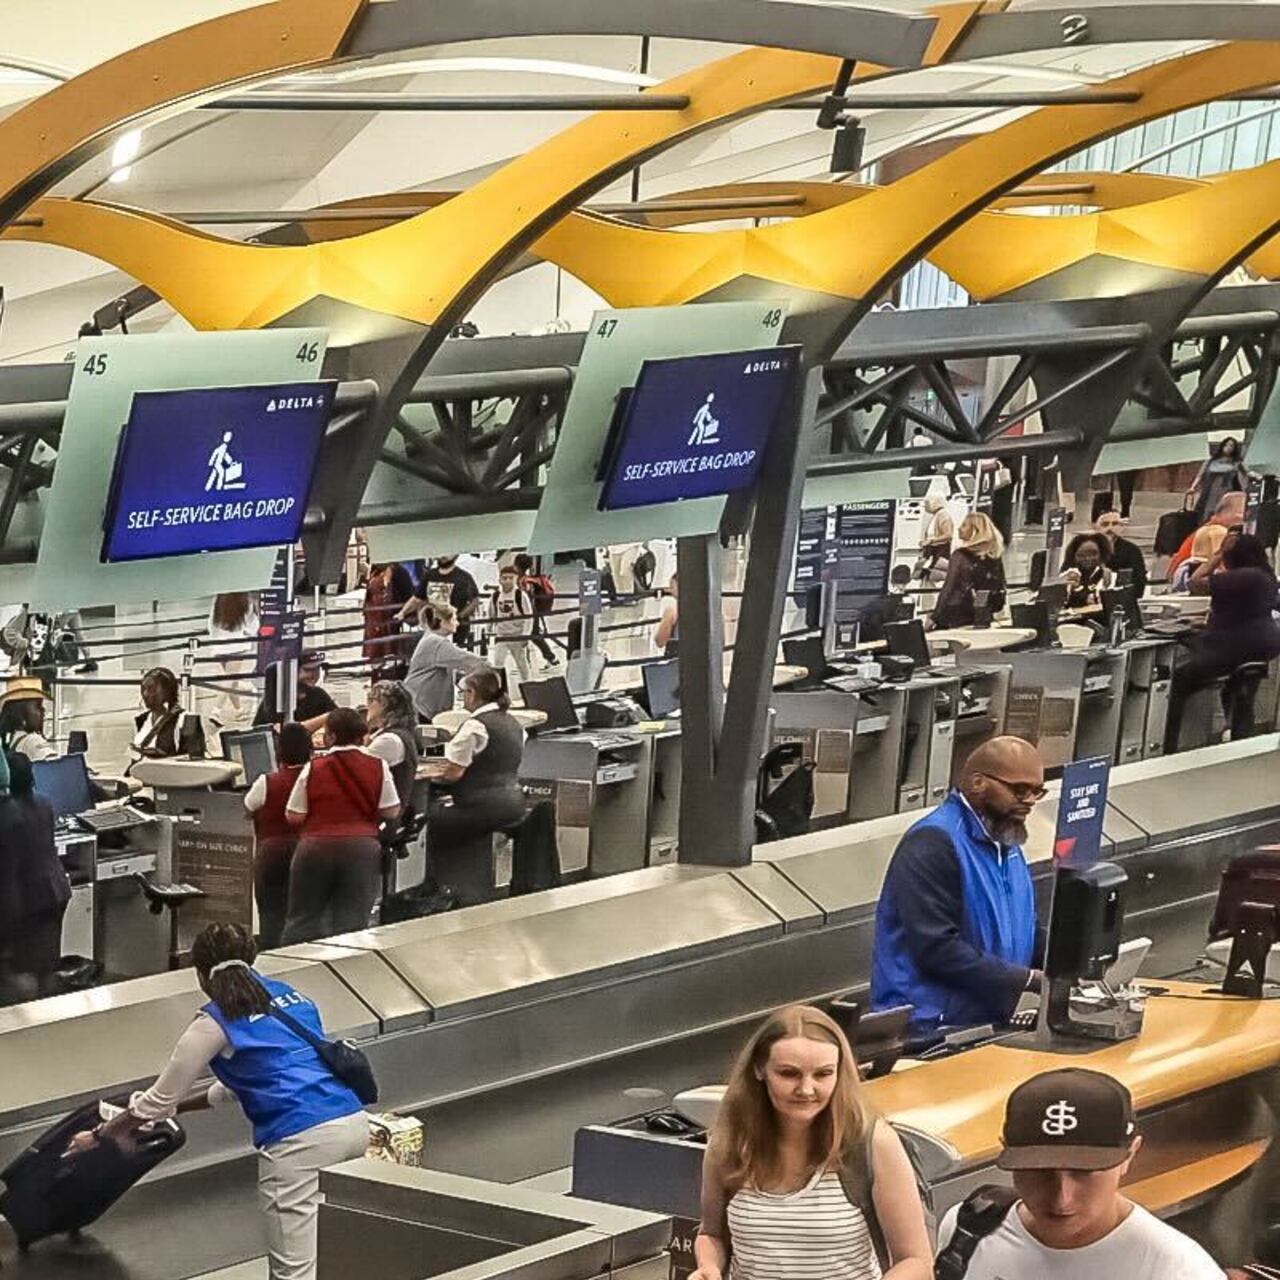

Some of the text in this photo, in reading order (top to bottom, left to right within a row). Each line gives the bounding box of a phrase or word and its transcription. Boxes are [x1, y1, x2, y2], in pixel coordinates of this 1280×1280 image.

[597, 320, 619, 338] 47
[762, 309, 782, 329] 48
[296, 342, 318, 362] 46
[83, 353, 108, 375] 45
[753, 360, 781, 373] DELTA
[278, 397, 314, 410] DELTA
[623, 450, 757, 481] SELF-SERVICE BAG DROP
[127, 496, 295, 529] SELF-SERVICE BAG DROP
[842, 502, 890, 511] PASSENGERS
